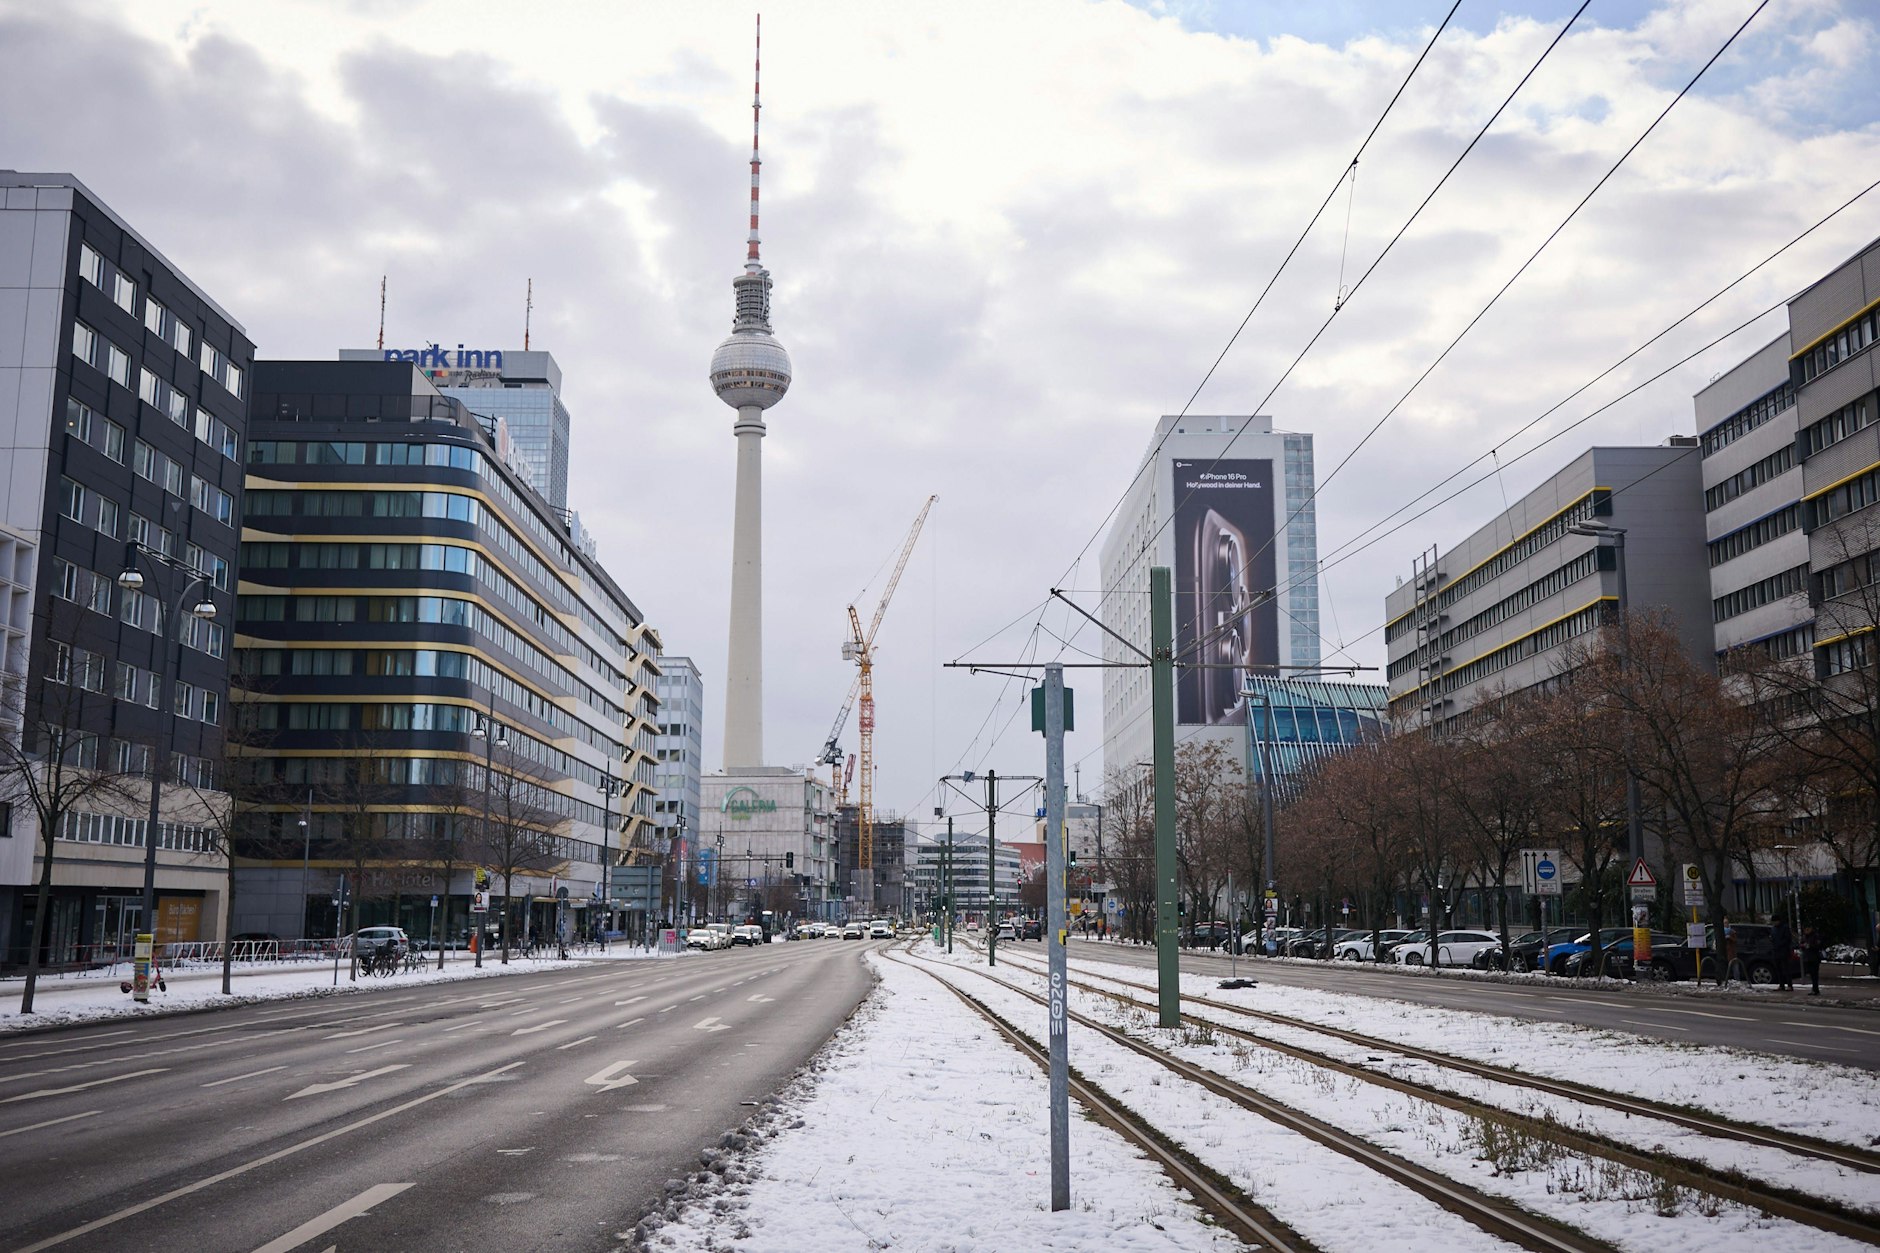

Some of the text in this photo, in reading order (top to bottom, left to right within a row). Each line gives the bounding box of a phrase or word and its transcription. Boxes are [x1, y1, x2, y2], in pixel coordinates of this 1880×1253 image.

[384, 344, 503, 369] park inn
[730, 799, 777, 813] GALERIA
